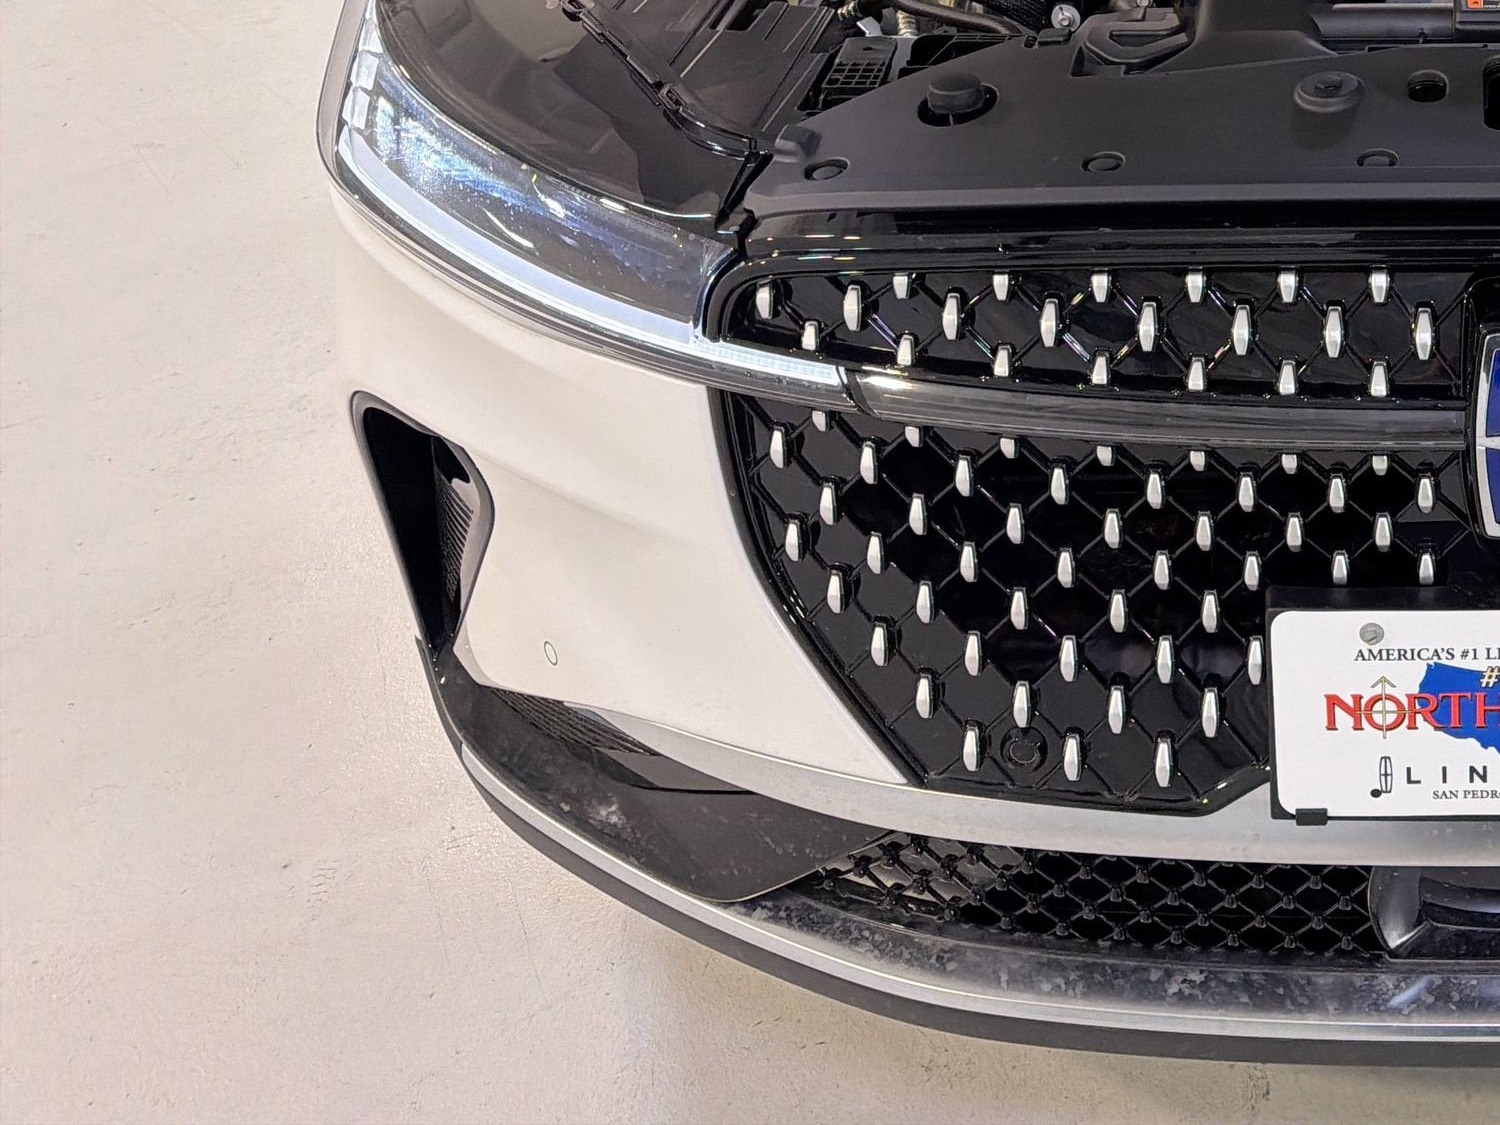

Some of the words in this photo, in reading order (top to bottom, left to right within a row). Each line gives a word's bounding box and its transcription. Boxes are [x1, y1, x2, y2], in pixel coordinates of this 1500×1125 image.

[1353, 648, 1456, 661] AMERICA'S
[1459, 648, 1479, 660] #1
[1432, 789, 1459, 799] SAN
